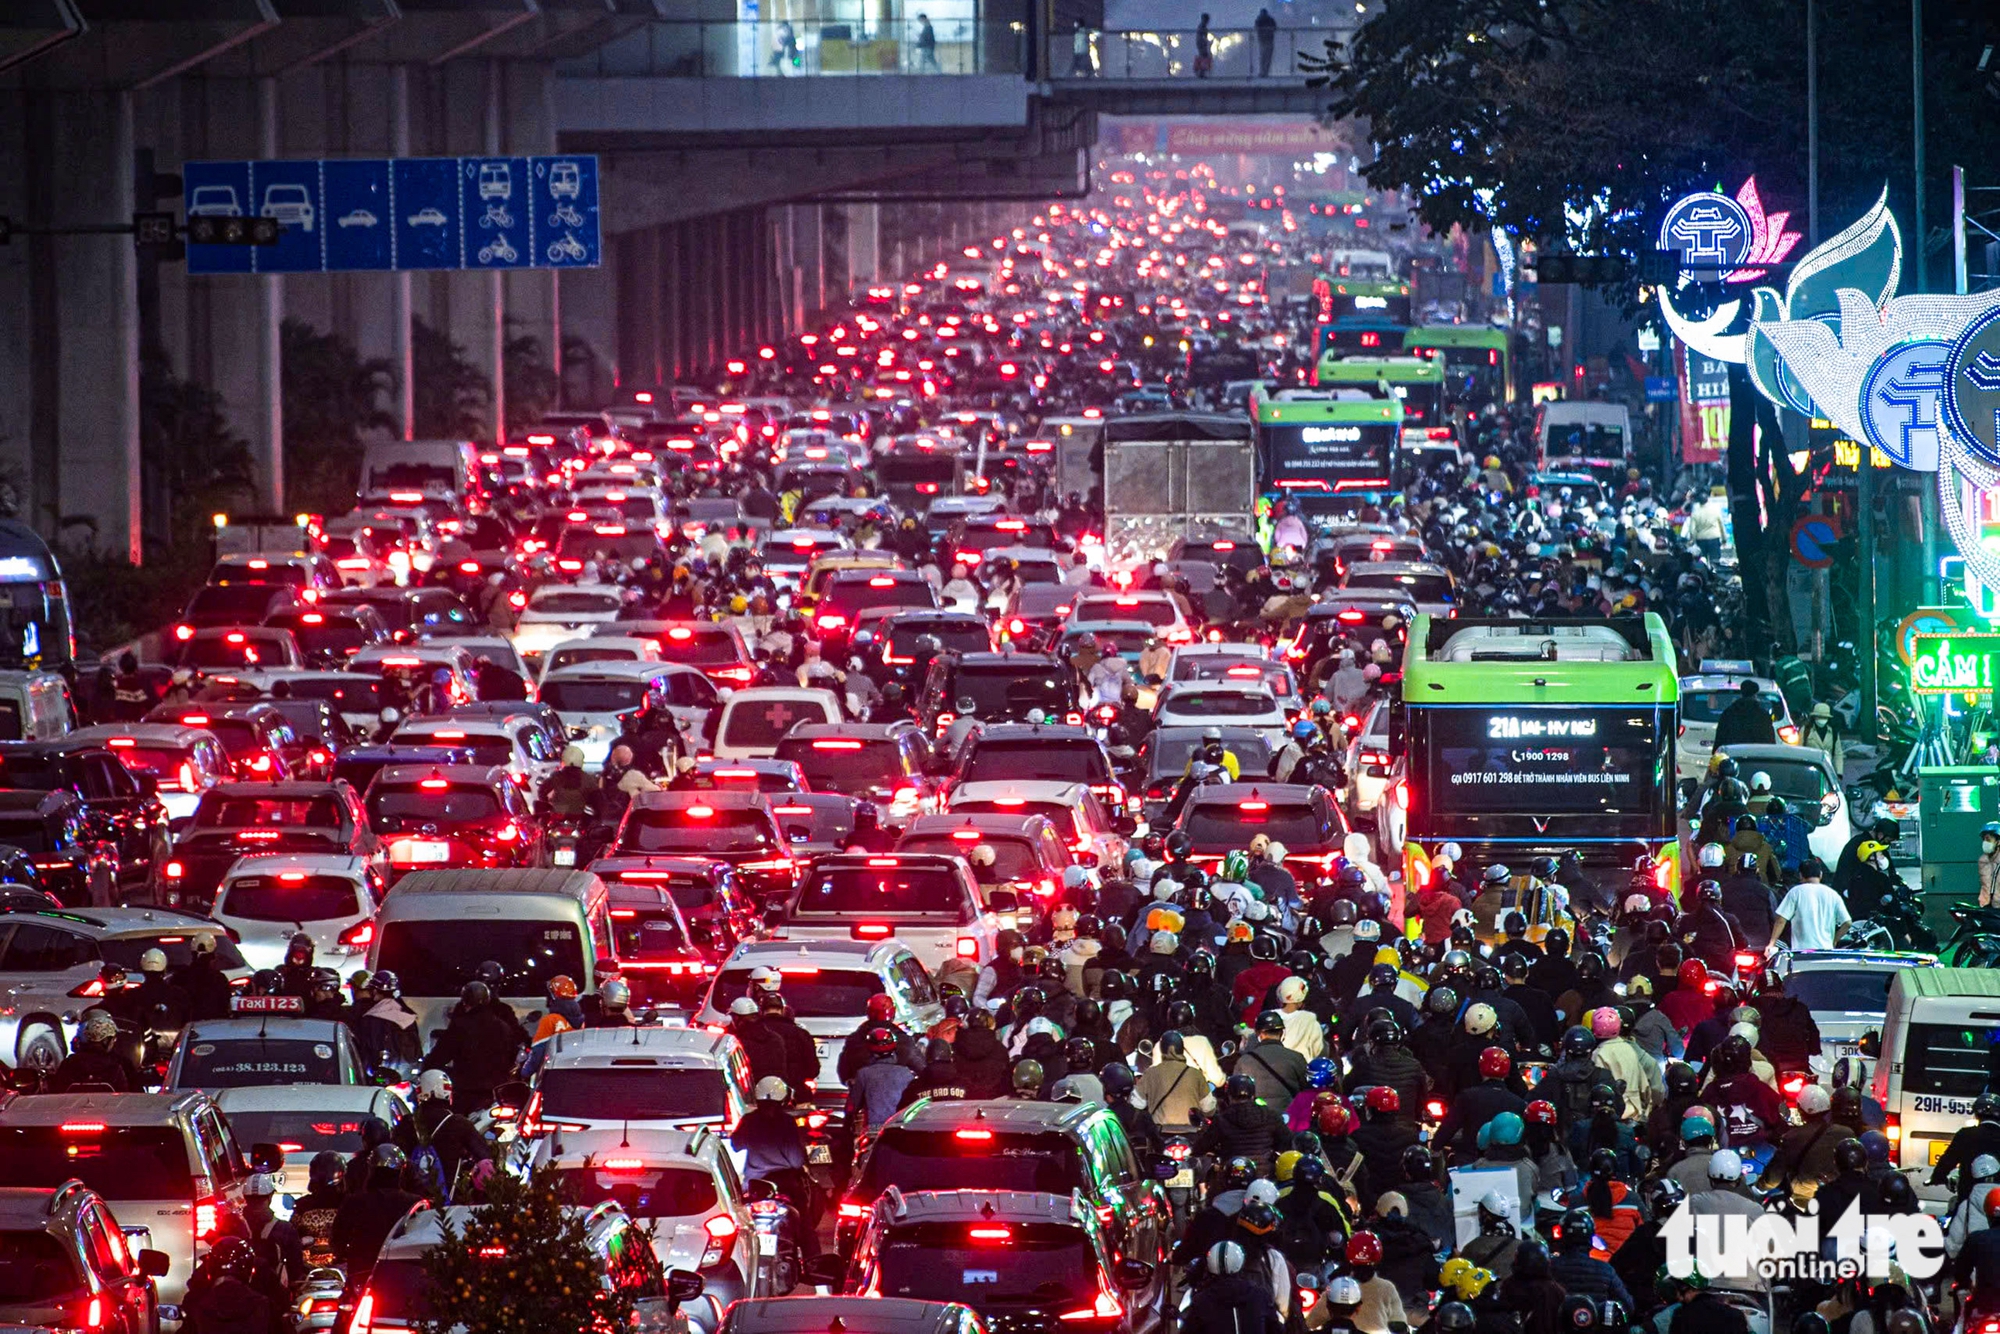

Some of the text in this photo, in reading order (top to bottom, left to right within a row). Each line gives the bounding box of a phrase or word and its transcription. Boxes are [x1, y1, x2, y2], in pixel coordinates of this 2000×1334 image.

[1490, 716, 1520, 738] 21A
[1520, 752, 1569, 761] 1900 1298
[1451, 774, 1462, 786] GỌI
[1463, 772, 1482, 784] 0917
[1483, 772, 1497, 784] 601
[1498, 772, 1513, 784] 298
[1573, 773, 1587, 783] VIÊN
[1588, 773, 1600, 783] BUS
[1614, 773, 1630, 783] NINH
[239, 997, 299, 1009] Taxi 123
[235, 1062, 306, 1073] 38.123.123
